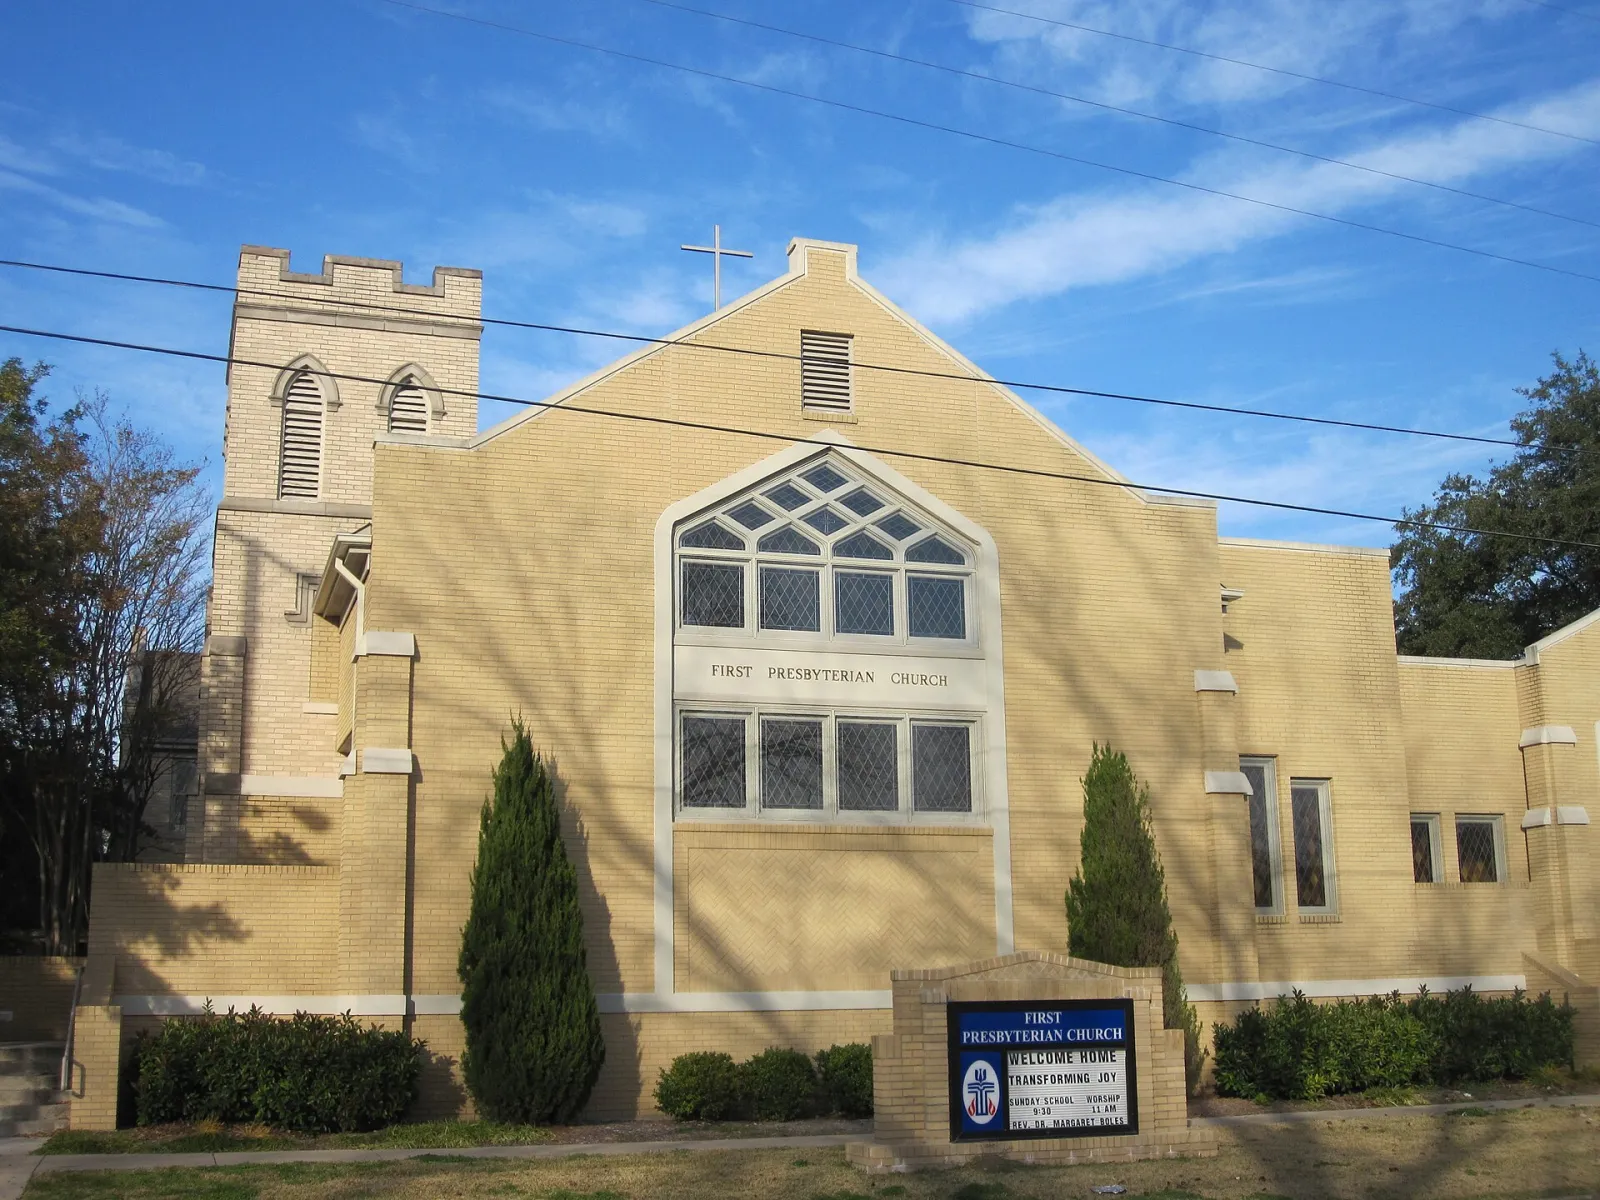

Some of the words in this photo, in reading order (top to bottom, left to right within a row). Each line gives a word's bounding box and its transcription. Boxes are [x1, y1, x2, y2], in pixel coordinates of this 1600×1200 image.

[711, 664, 753, 678] FIRST
[768, 666, 875, 683] PRESBYTERIAN
[890, 672, 948, 687] CHURCH
[1024, 1011, 1062, 1025] FIRST
[962, 1029, 1063, 1044] PRESBYTERIAN
[1066, 1027, 1123, 1041] CHURCH
[1009, 1050, 1074, 1066] WELCOME
[1080, 1050, 1117, 1064] HOME
[1008, 1073, 1090, 1086] TRANSFORMING
[1097, 1072, 1117, 1083] JOY
[1009, 1097, 1040, 1106] SUNDAY
[1044, 1096, 1075, 1105] SCHOOL
[1086, 1095, 1121, 1103] WORSHIP
[1033, 1108, 1052, 1116] 9:30
[1091, 1106, 1100, 1114] 11
[1104, 1105, 1117, 1113] AM
[1012, 1121, 1031, 1130] REV.
[1035, 1120, 1048, 1128] DR.
[1053, 1118, 1095, 1128] MARGARET
[1100, 1117, 1124, 1125] BOLES
